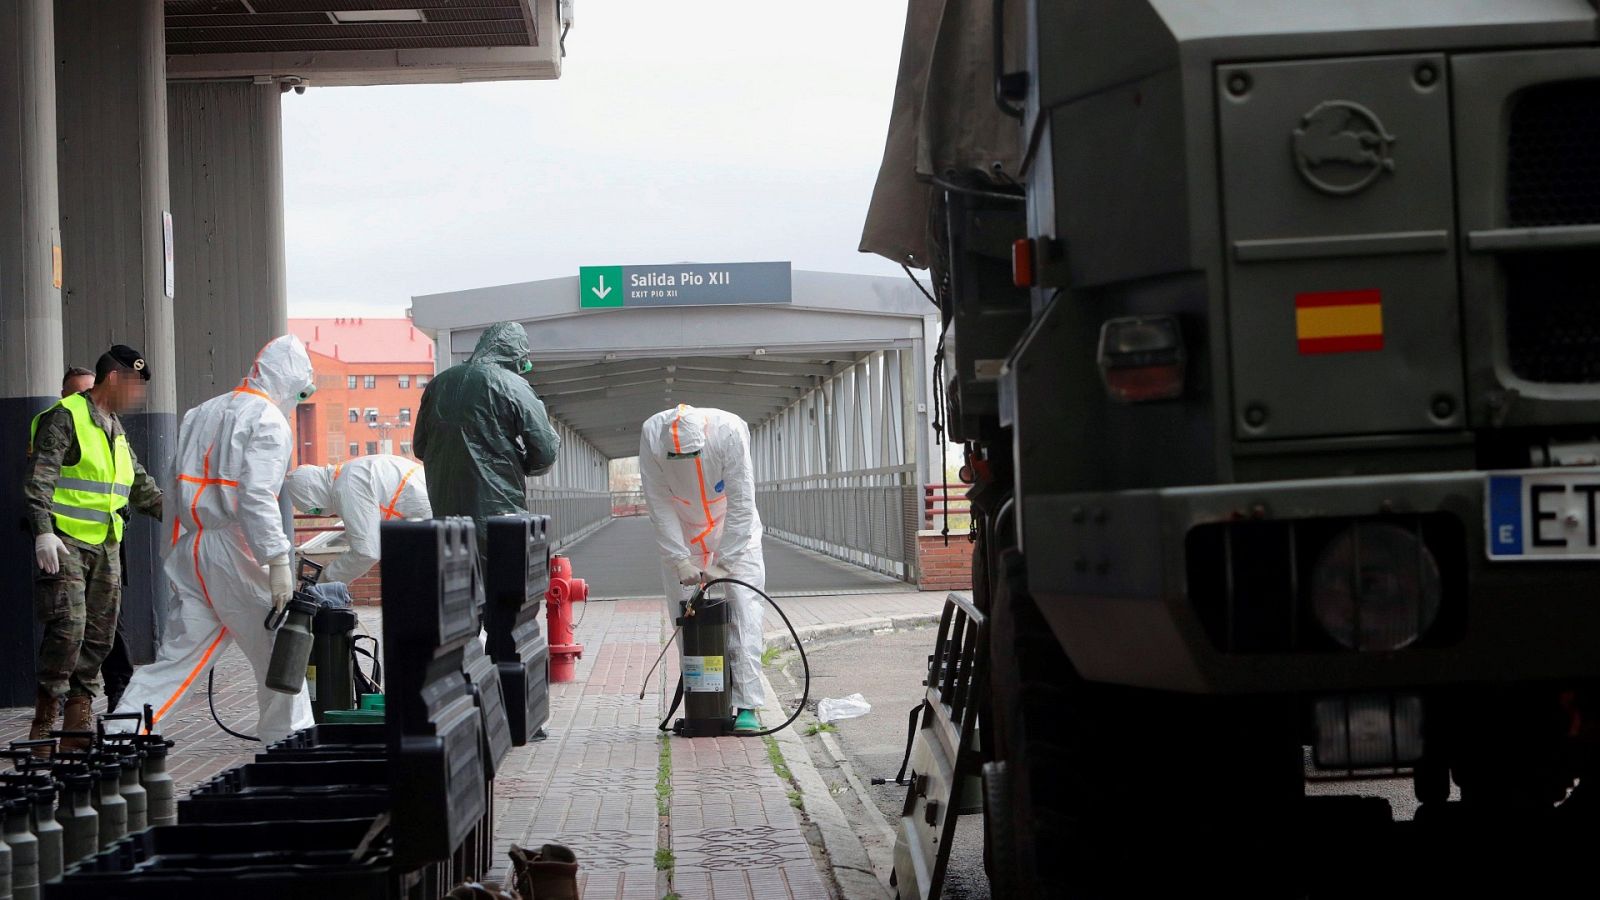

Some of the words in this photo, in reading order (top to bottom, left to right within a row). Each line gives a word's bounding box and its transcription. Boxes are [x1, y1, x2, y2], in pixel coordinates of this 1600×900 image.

[631, 273, 675, 287] Salida
[681, 272, 703, 286] Pio
[708, 271, 730, 285] XII
[651, 290, 664, 298] PIO
[1531, 485, 1600, 547] ET
[1499, 525, 1515, 544] E
